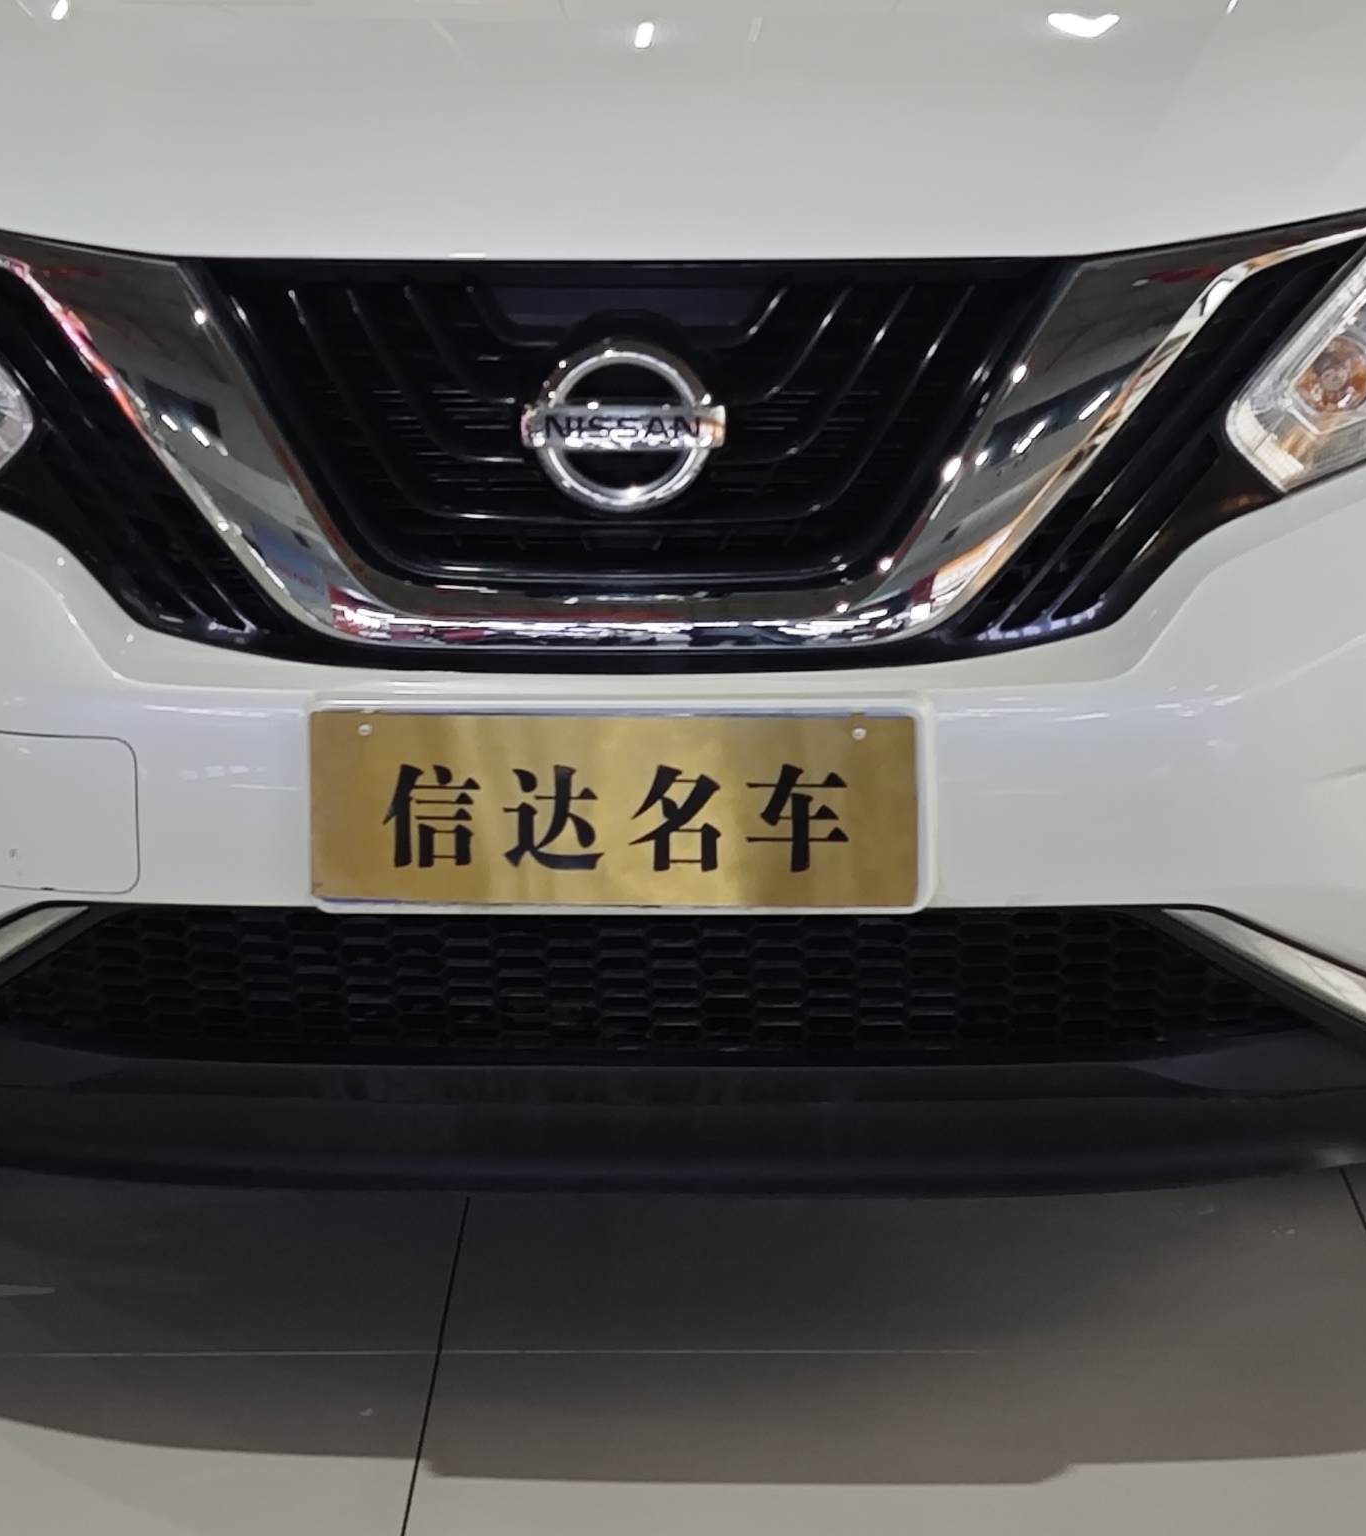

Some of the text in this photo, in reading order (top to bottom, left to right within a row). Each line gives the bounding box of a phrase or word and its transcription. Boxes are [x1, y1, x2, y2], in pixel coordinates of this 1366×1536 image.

[545, 415, 701, 439] NISSAN
[382, 763, 850, 873] 信达名车
